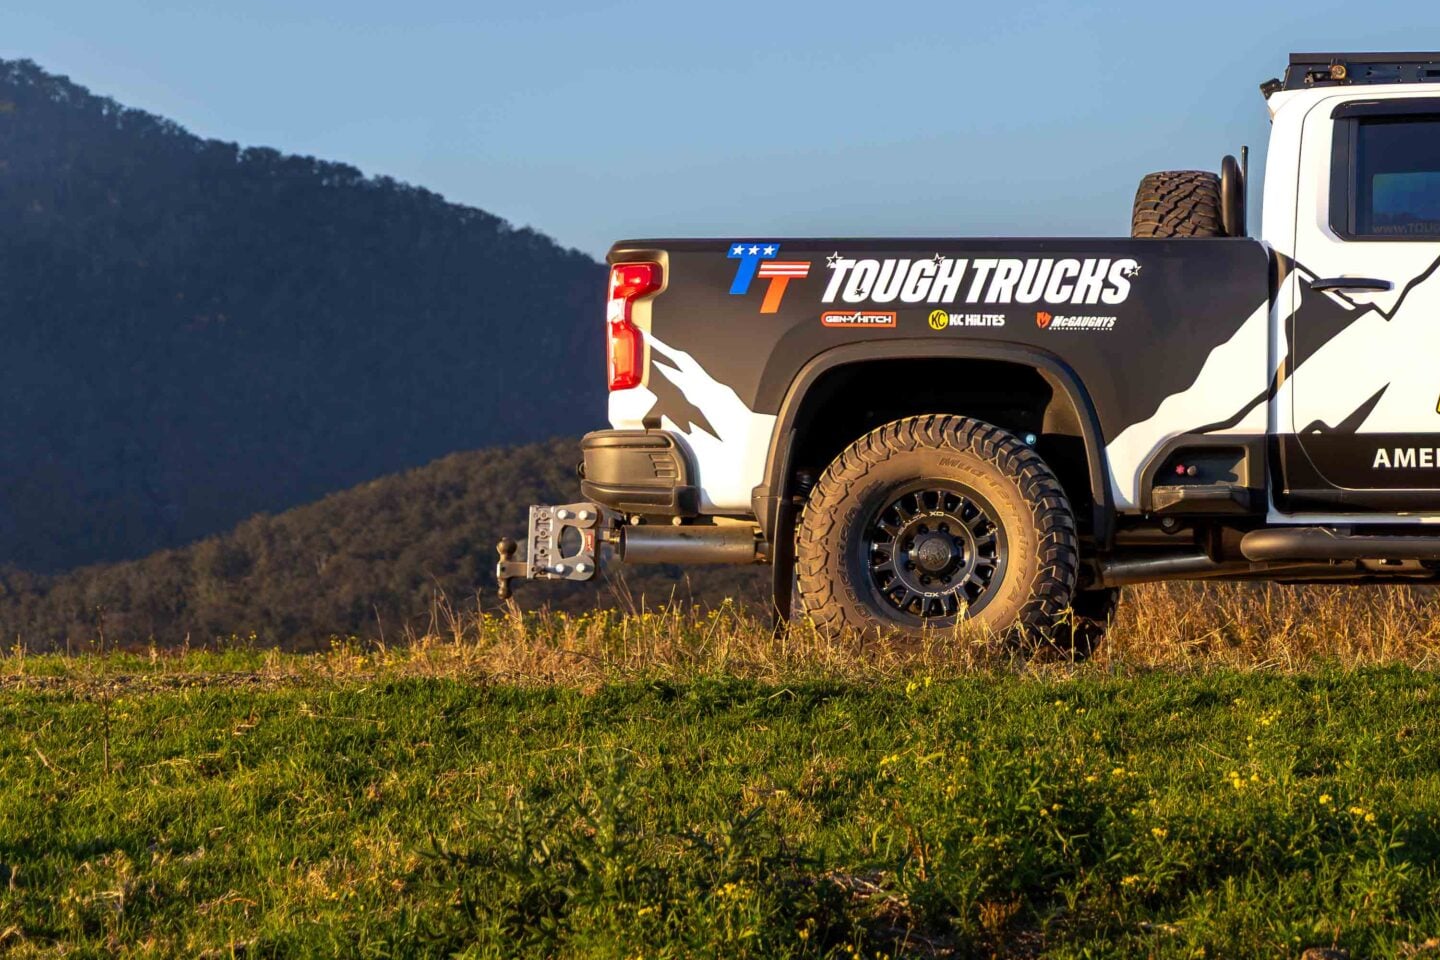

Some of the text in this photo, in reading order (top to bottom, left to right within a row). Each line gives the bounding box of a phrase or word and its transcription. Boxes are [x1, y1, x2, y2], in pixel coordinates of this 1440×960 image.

[727, 243, 811, 313] TT
[821, 254, 1138, 304] TOUGH TRUCKS
[859, 315, 891, 323] HITCH
[932, 312, 945, 327] KC
[949, 314, 964, 326] KC
